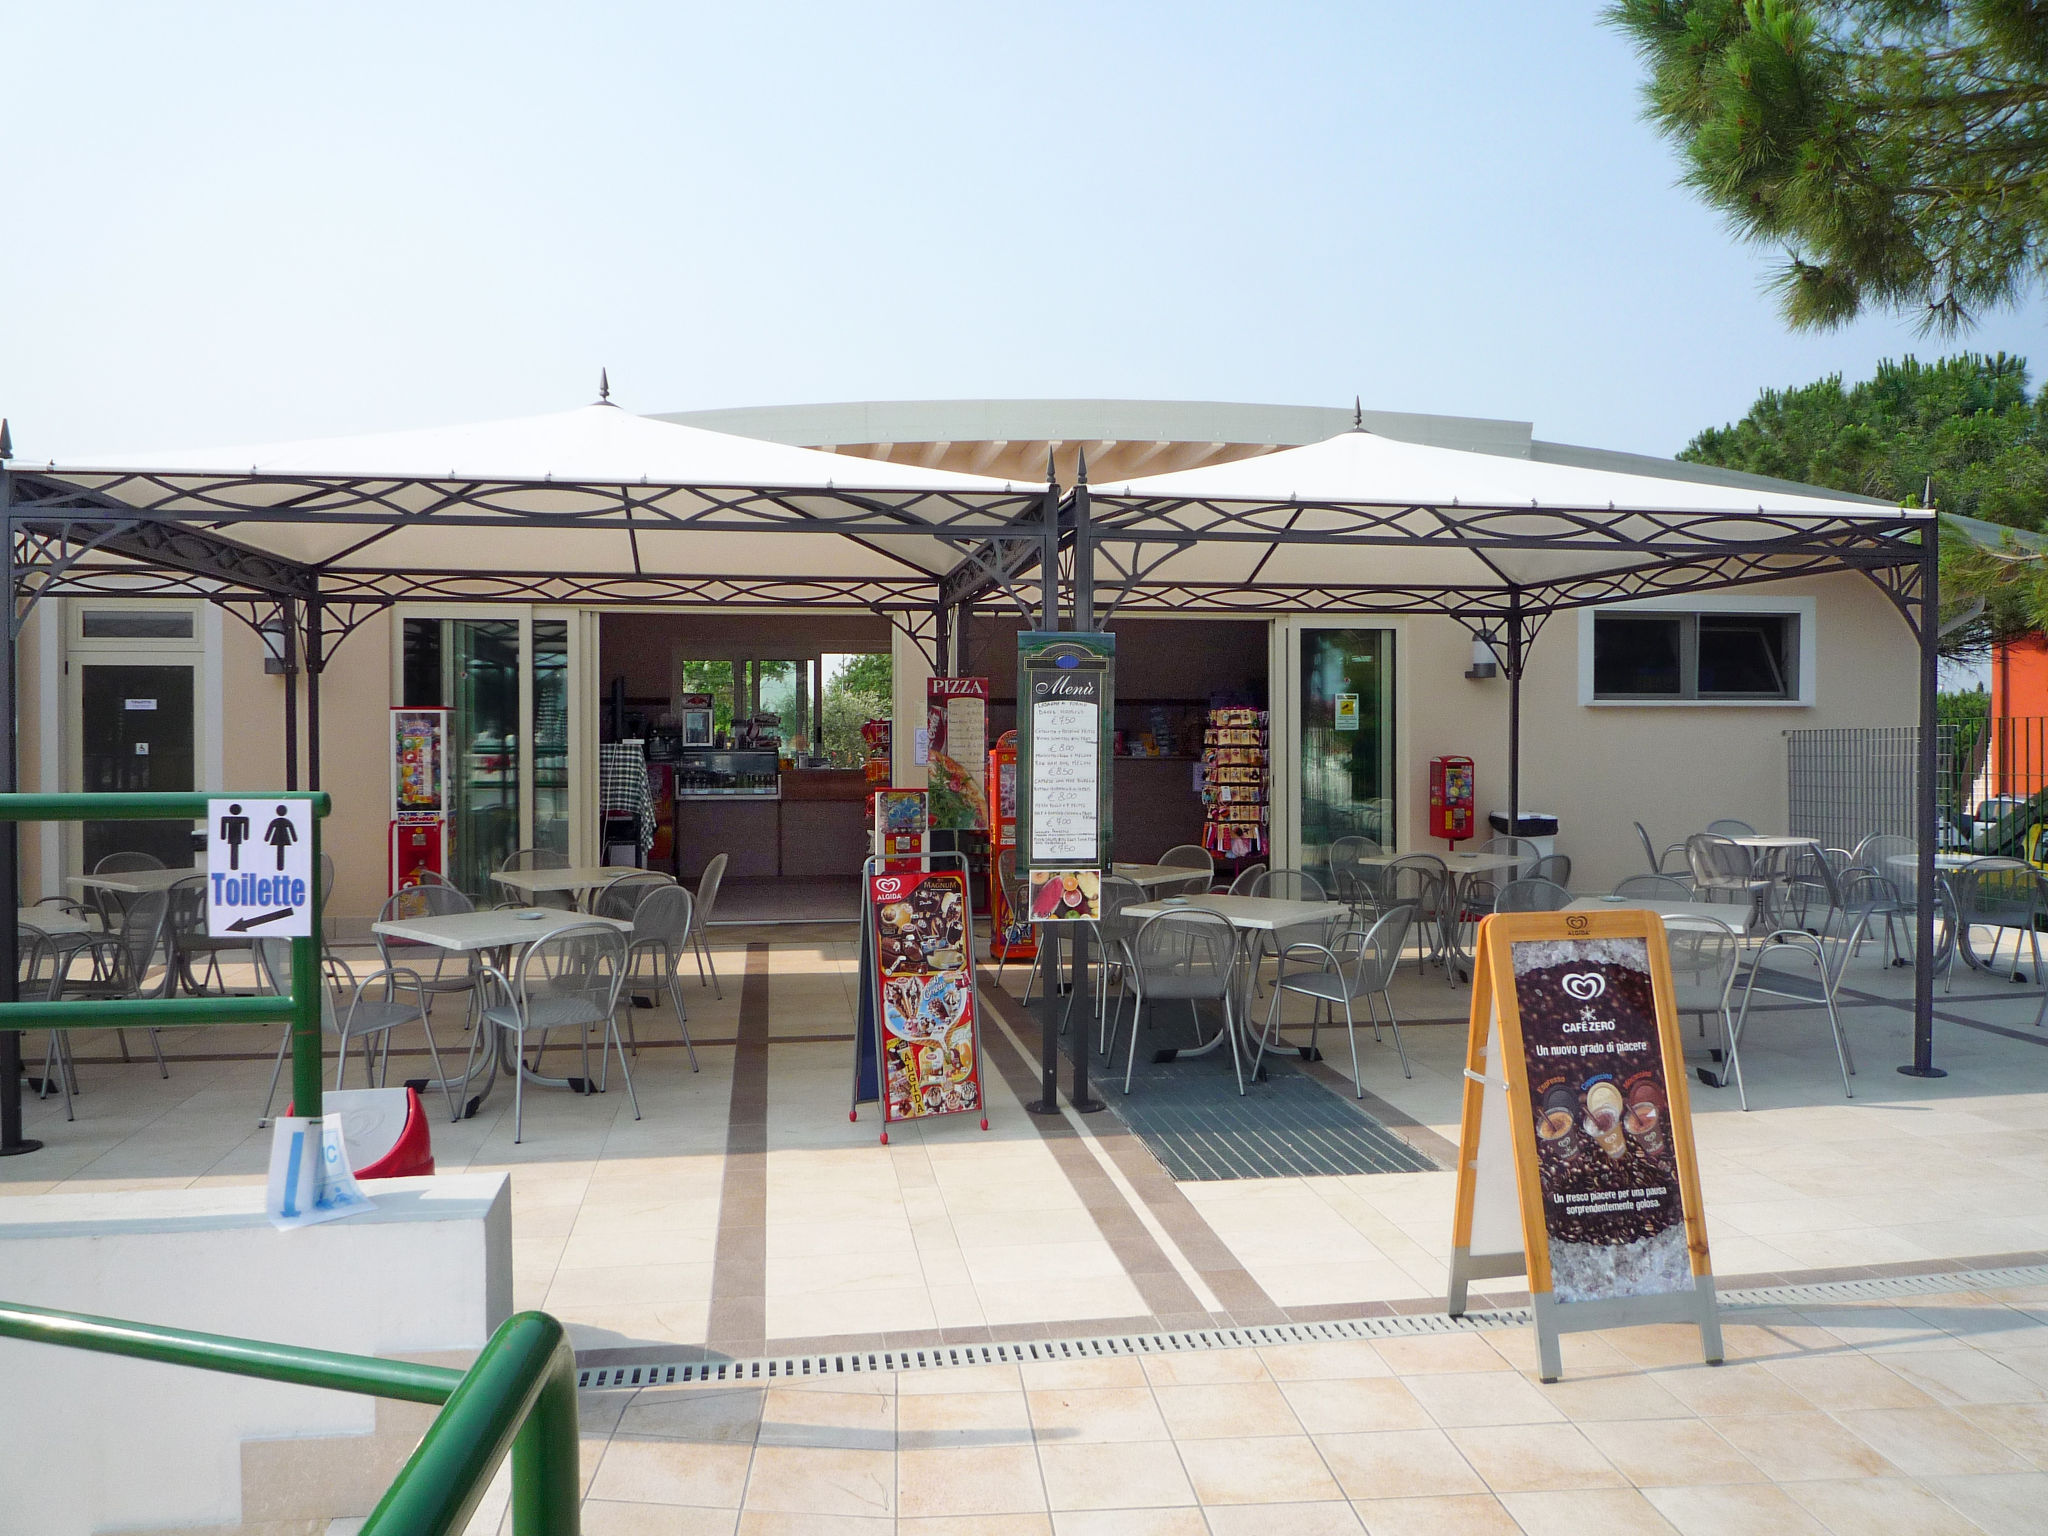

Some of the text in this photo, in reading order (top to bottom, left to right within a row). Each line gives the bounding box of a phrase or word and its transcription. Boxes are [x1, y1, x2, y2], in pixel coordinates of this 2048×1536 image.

[933, 680, 983, 694] PIZZA
[1035, 675, 1095, 695] Menù
[211, 873, 305, 907] Toilette
[877, 892, 902, 901] ALGIDA
[1536, 1041, 1647, 1056] Un nuovo grado di piacere
[1537, 1076, 1566, 1094] Espresso
[1553, 1187, 1667, 1203] Un fresco piacere per una pausa
[1566, 1201, 1634, 1216] sorprendentemente
